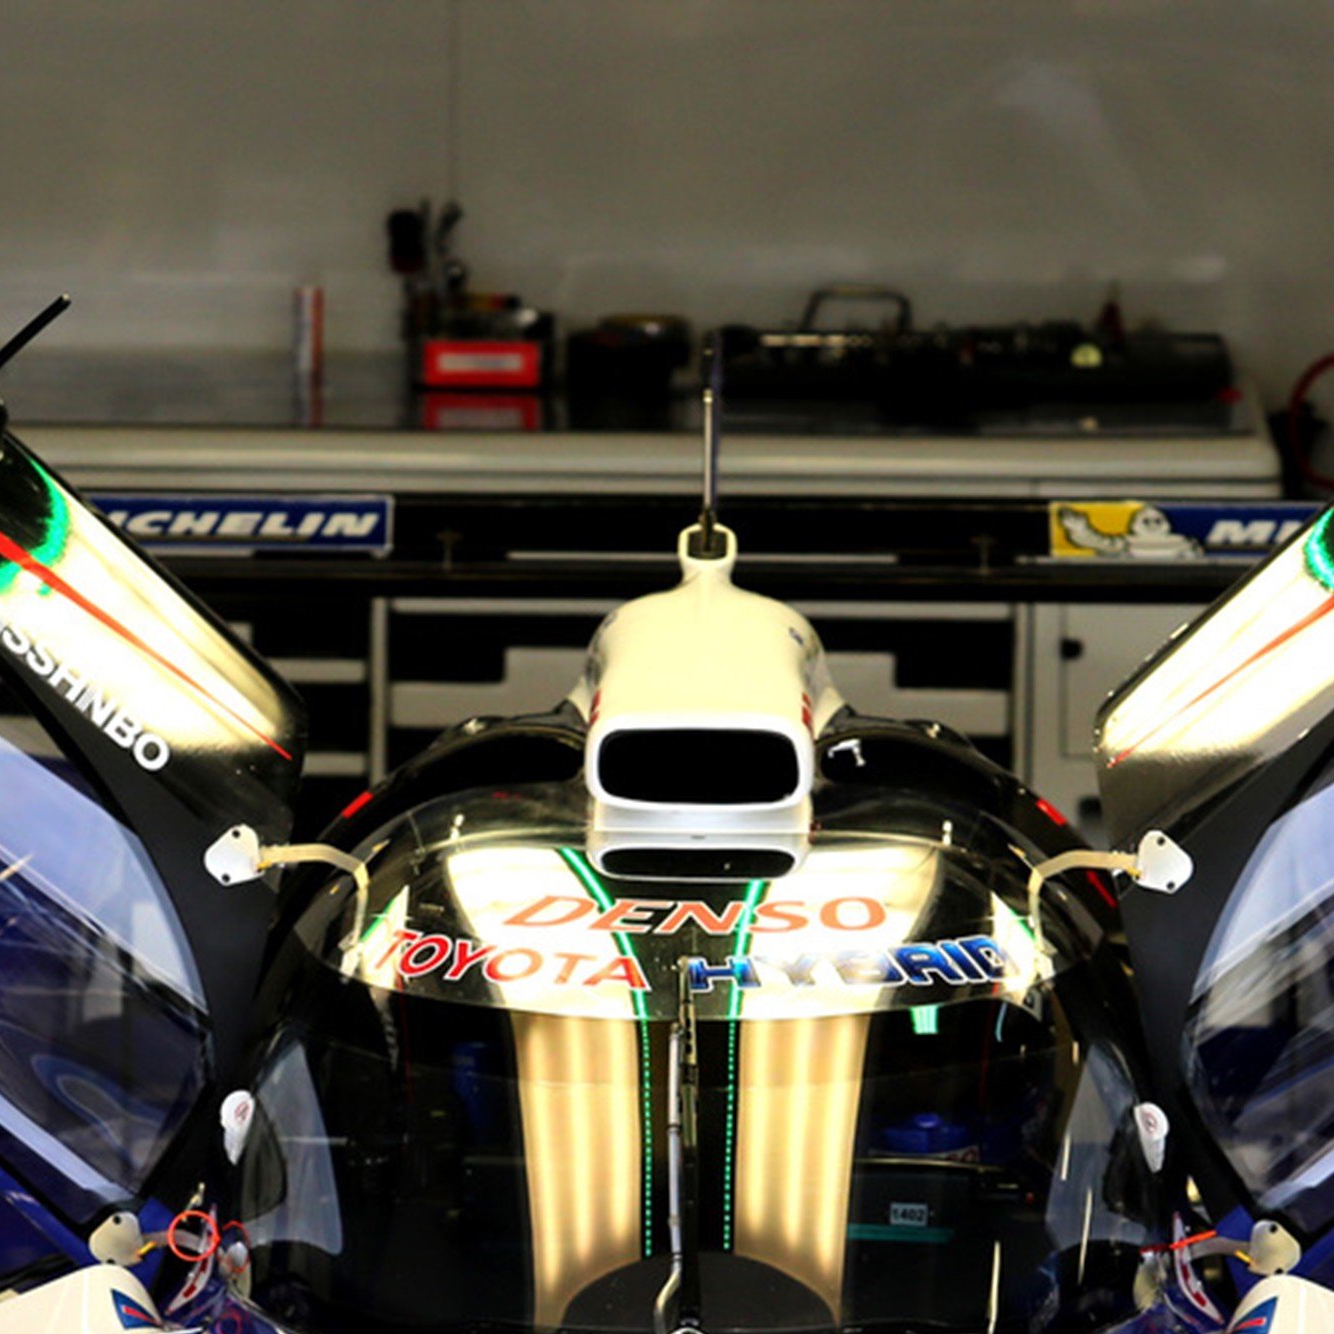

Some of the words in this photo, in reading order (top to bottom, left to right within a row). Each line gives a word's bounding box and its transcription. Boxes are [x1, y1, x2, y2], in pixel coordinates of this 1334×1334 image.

[502, 895, 888, 937] DENSO
[374, 928, 651, 992] TOYOTA
[686, 934, 1020, 993] HYBRID
